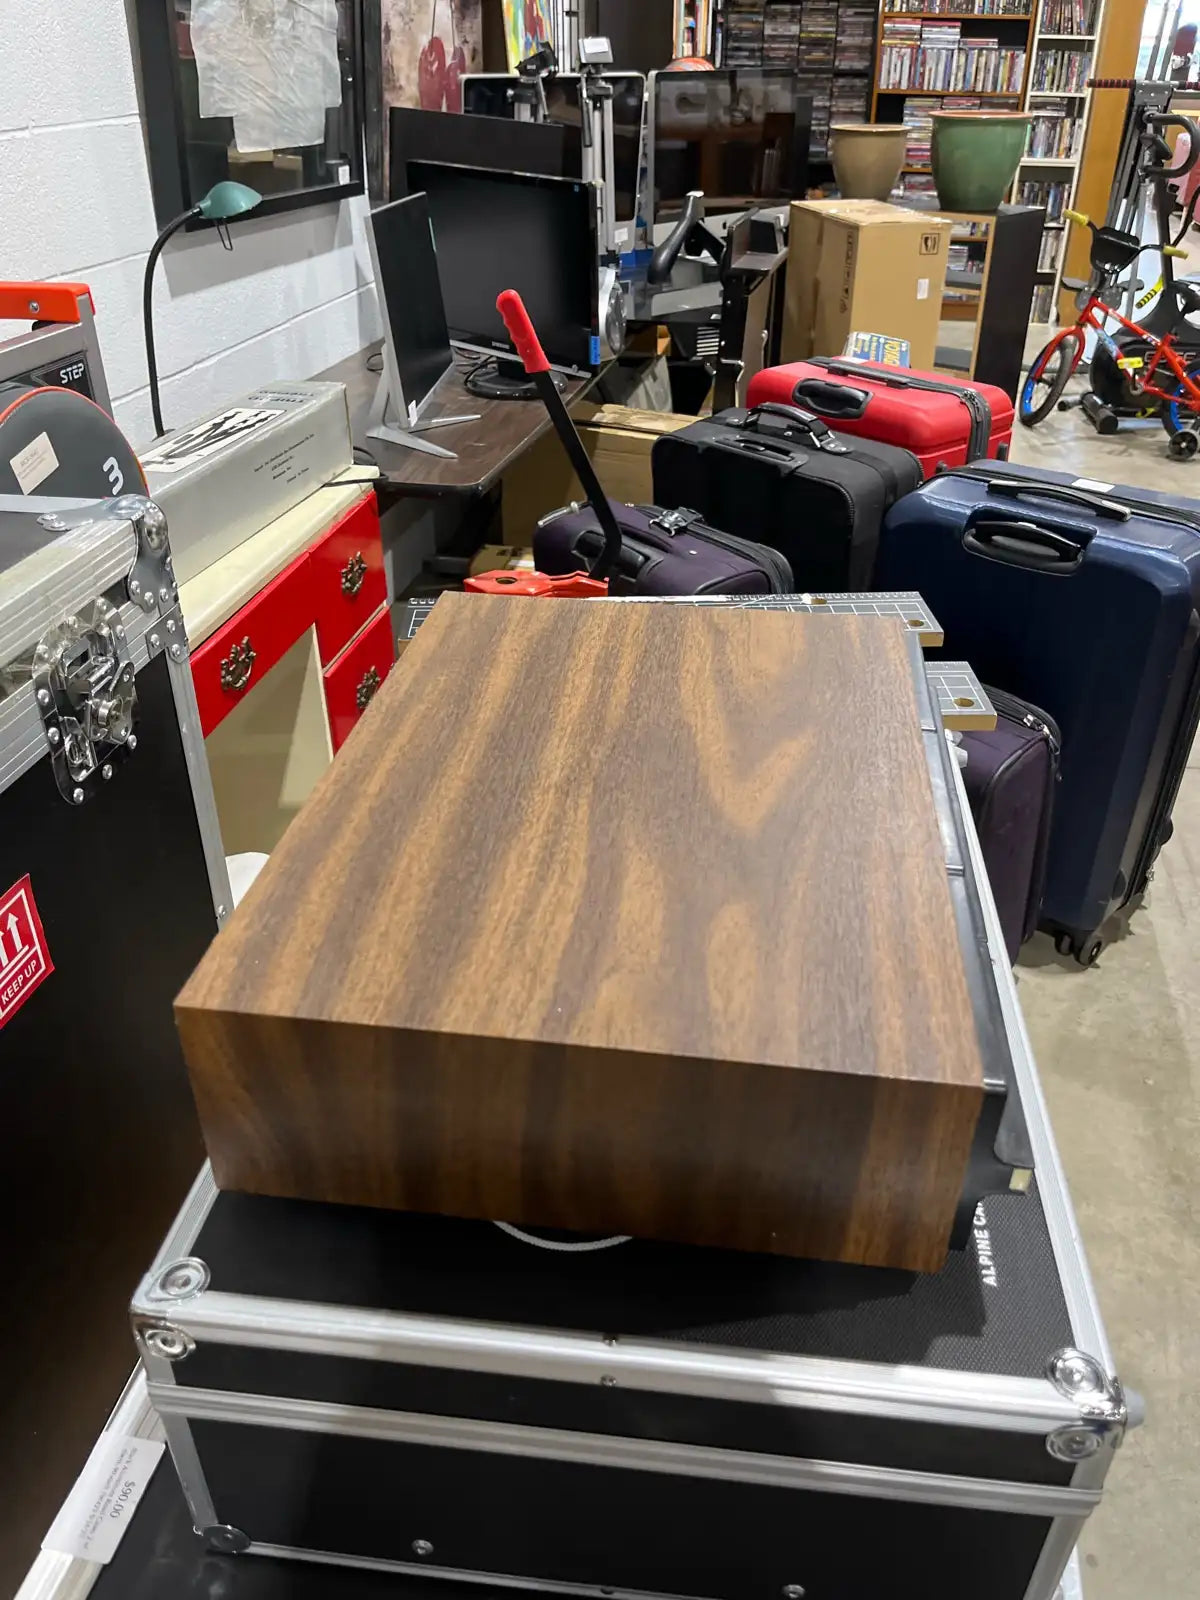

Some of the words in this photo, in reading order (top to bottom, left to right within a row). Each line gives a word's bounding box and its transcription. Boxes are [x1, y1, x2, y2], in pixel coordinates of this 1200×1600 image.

[60, 363, 84, 384] STEP
[103, 456, 125, 495] 3
[1, 976, 24, 1004] KEEP
[25, 959, 38, 979] UP
[974, 1228, 998, 1288] ALPINE
[109, 1480, 136, 1519] $90.00
